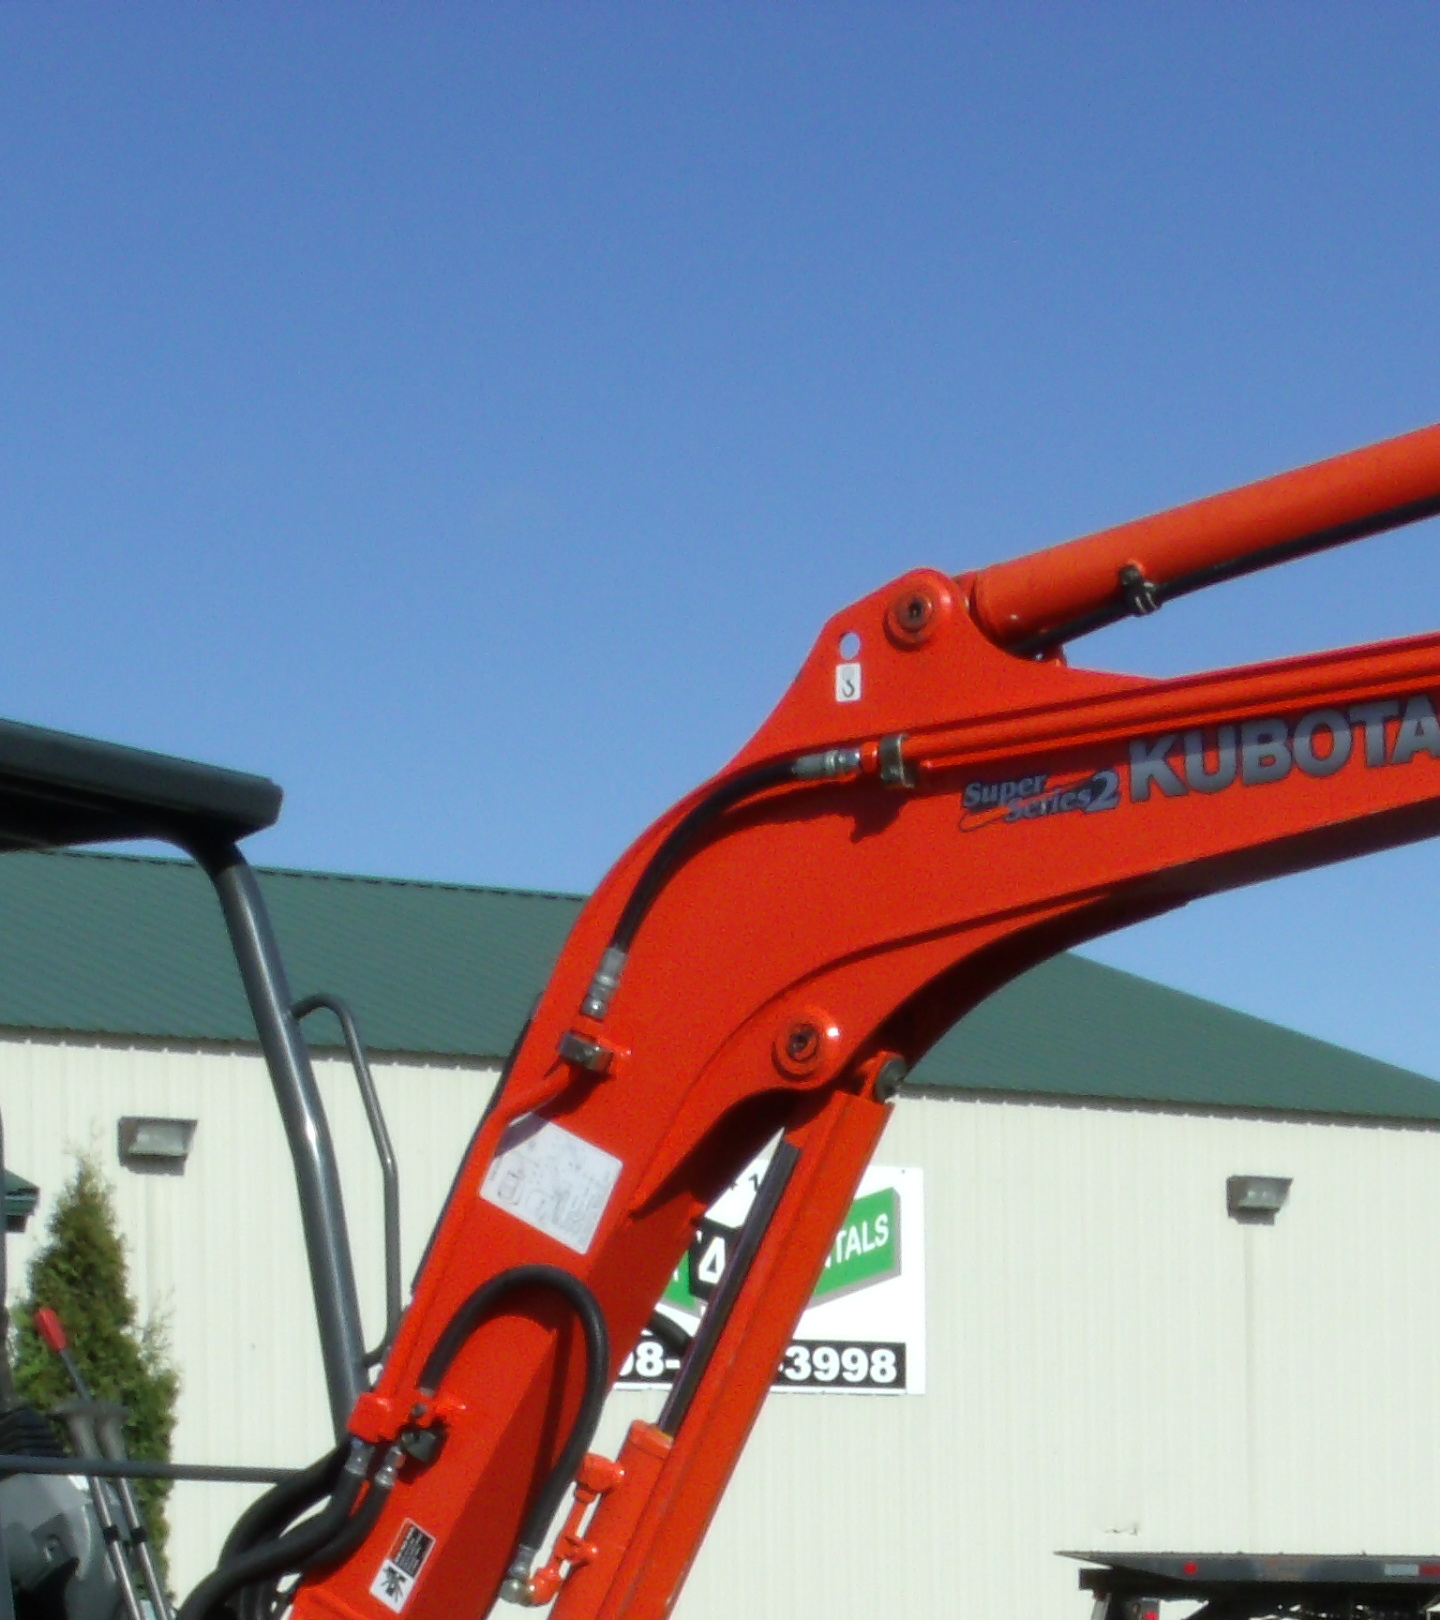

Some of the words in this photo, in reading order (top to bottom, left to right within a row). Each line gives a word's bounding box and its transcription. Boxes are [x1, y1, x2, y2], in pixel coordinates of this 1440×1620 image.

[962, 774, 1048, 809] Super
[1003, 788, 1093, 823] Series
[1081, 769, 1120, 814] 2
